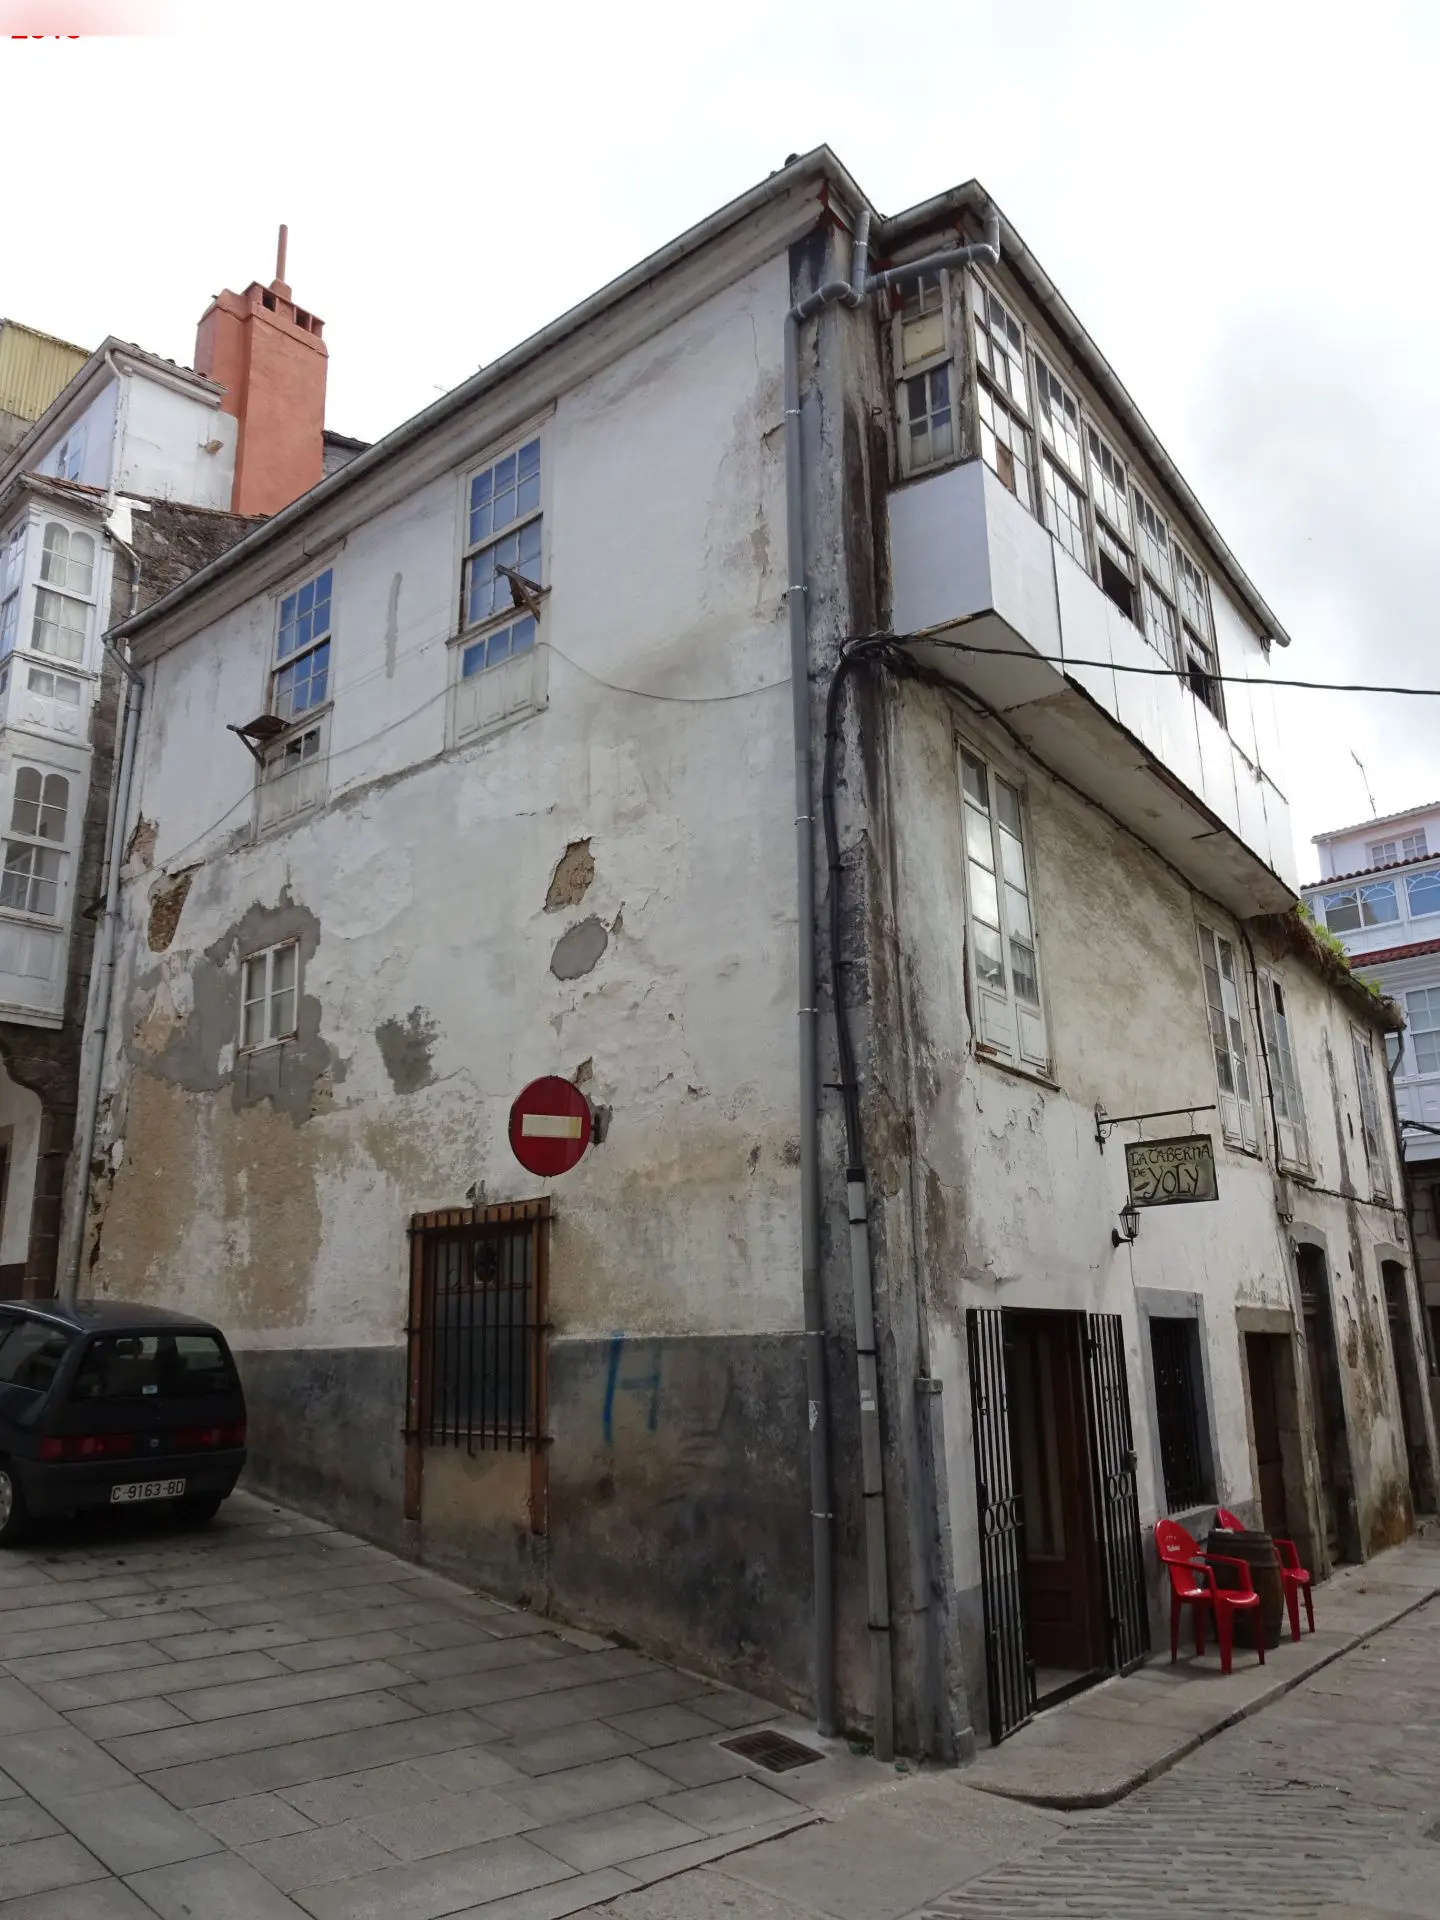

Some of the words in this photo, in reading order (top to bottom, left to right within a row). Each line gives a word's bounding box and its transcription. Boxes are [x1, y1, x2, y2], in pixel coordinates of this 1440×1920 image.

[1130, 1151, 1148, 1165] LA
[1132, 1167, 1147, 1178] DE
[1143, 1163, 1199, 1199] YOLY
